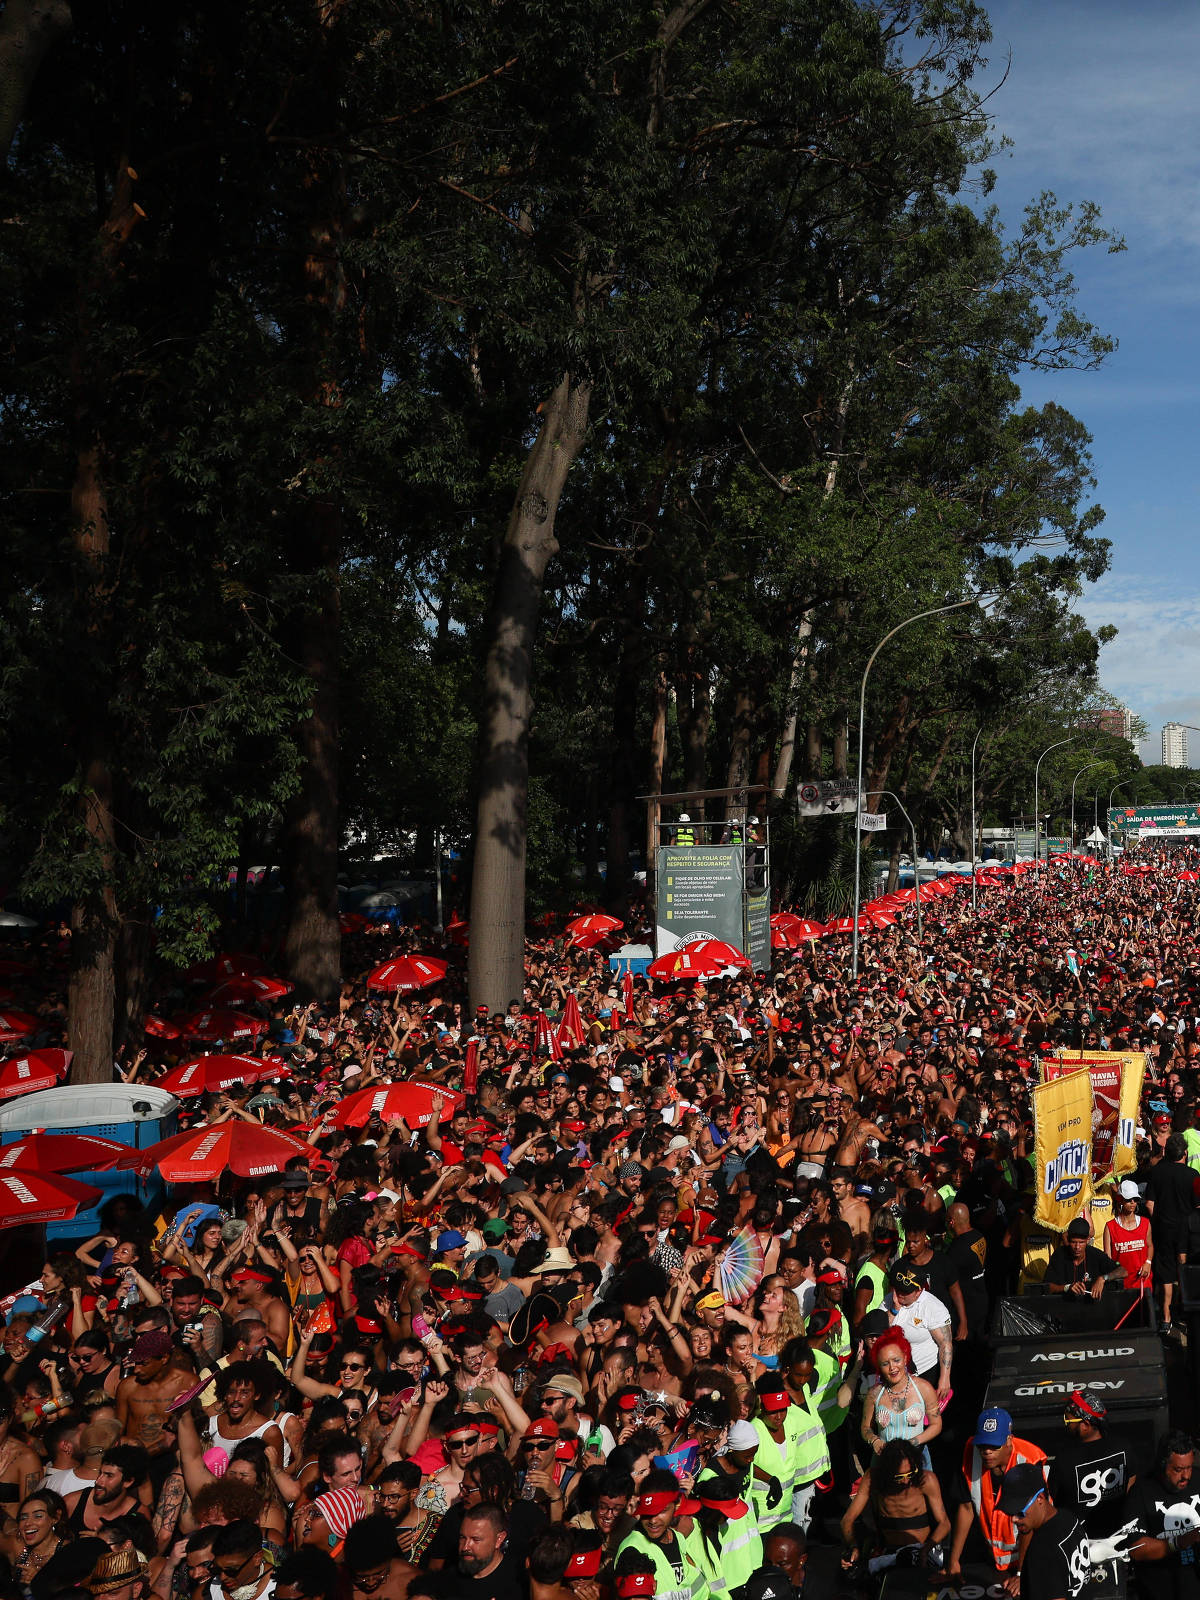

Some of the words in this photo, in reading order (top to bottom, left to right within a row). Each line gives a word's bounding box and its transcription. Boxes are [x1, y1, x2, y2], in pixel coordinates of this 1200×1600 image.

[1127, 815, 1144, 823] SAÍDA
[1153, 813, 1189, 821] EMERGÊNCIA
[1057, 1120, 1067, 1133] VEM
[1068, 1117, 1081, 1129] PRO
[190, 1131, 225, 1161] BRAHMA
[249, 1163, 278, 1177] BRAHMA
[1030, 1346, 1136, 1363] ambev
[1013, 1379, 1127, 1398] ambev
